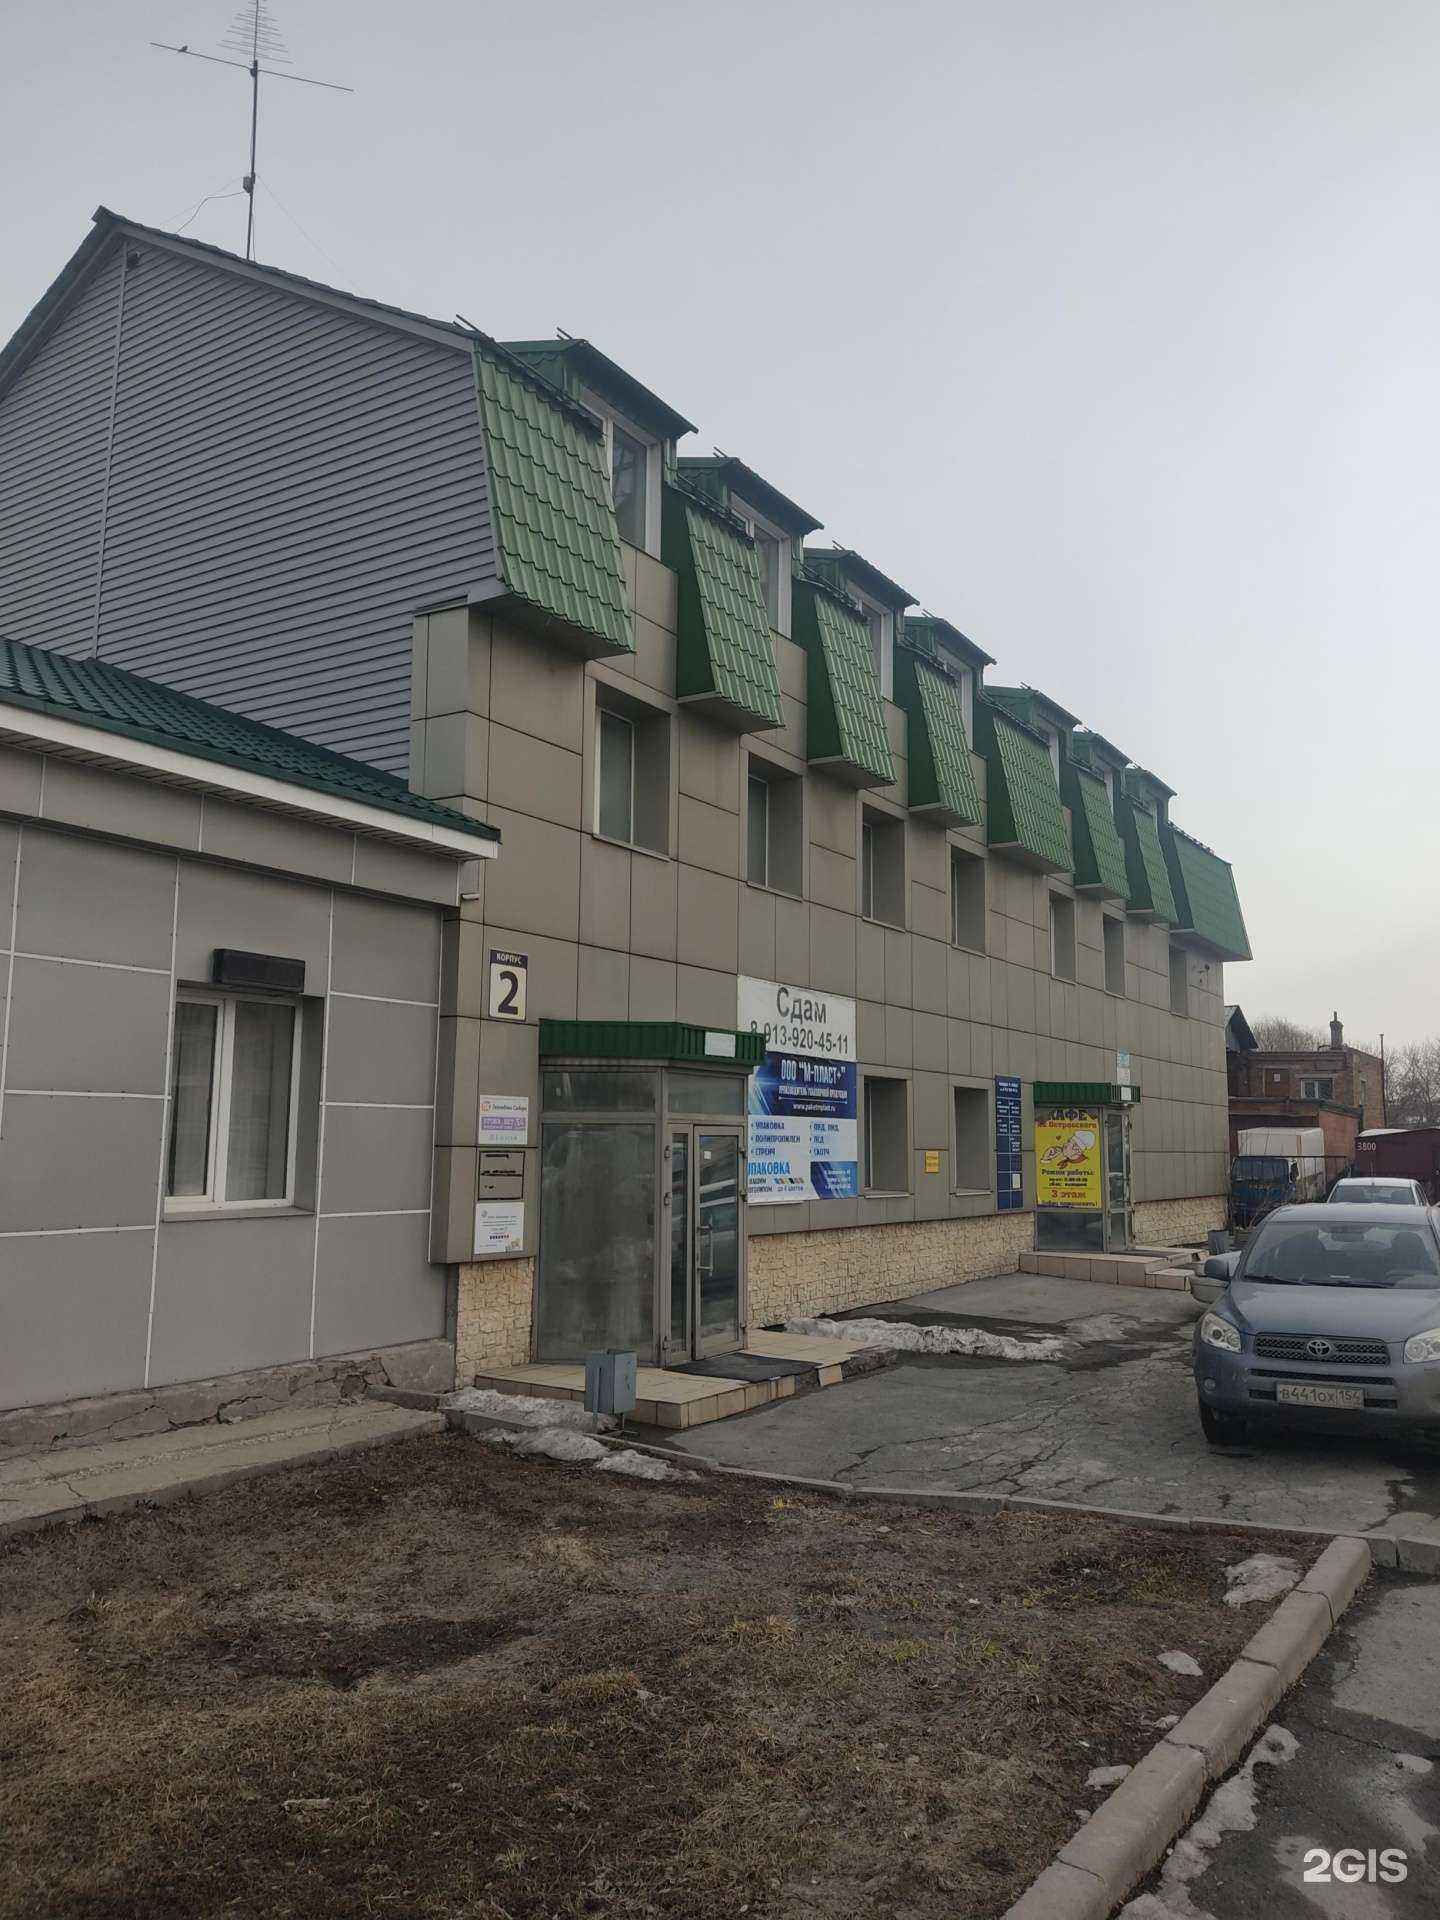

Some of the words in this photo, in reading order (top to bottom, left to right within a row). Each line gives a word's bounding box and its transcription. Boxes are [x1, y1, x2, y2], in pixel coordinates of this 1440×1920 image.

[496, 953, 521, 964] КОРПУС
[498, 971, 519, 1015] 2
[777, 987, 827, 1025] Сдам
[764, 1022, 848, 1054] 913-920-45-11
[781, 1059, 797, 1081] ООО
[755, 1121, 785, 1130] УПАКОВКА
[755, 1135, 801, 1143] ПОЛИПРОПИЛЕН
[1357, 1142, 1377, 1151] 3800
[1051, 1189, 1058, 1198] 3
[1339, 1390, 1361, 1402] 154
